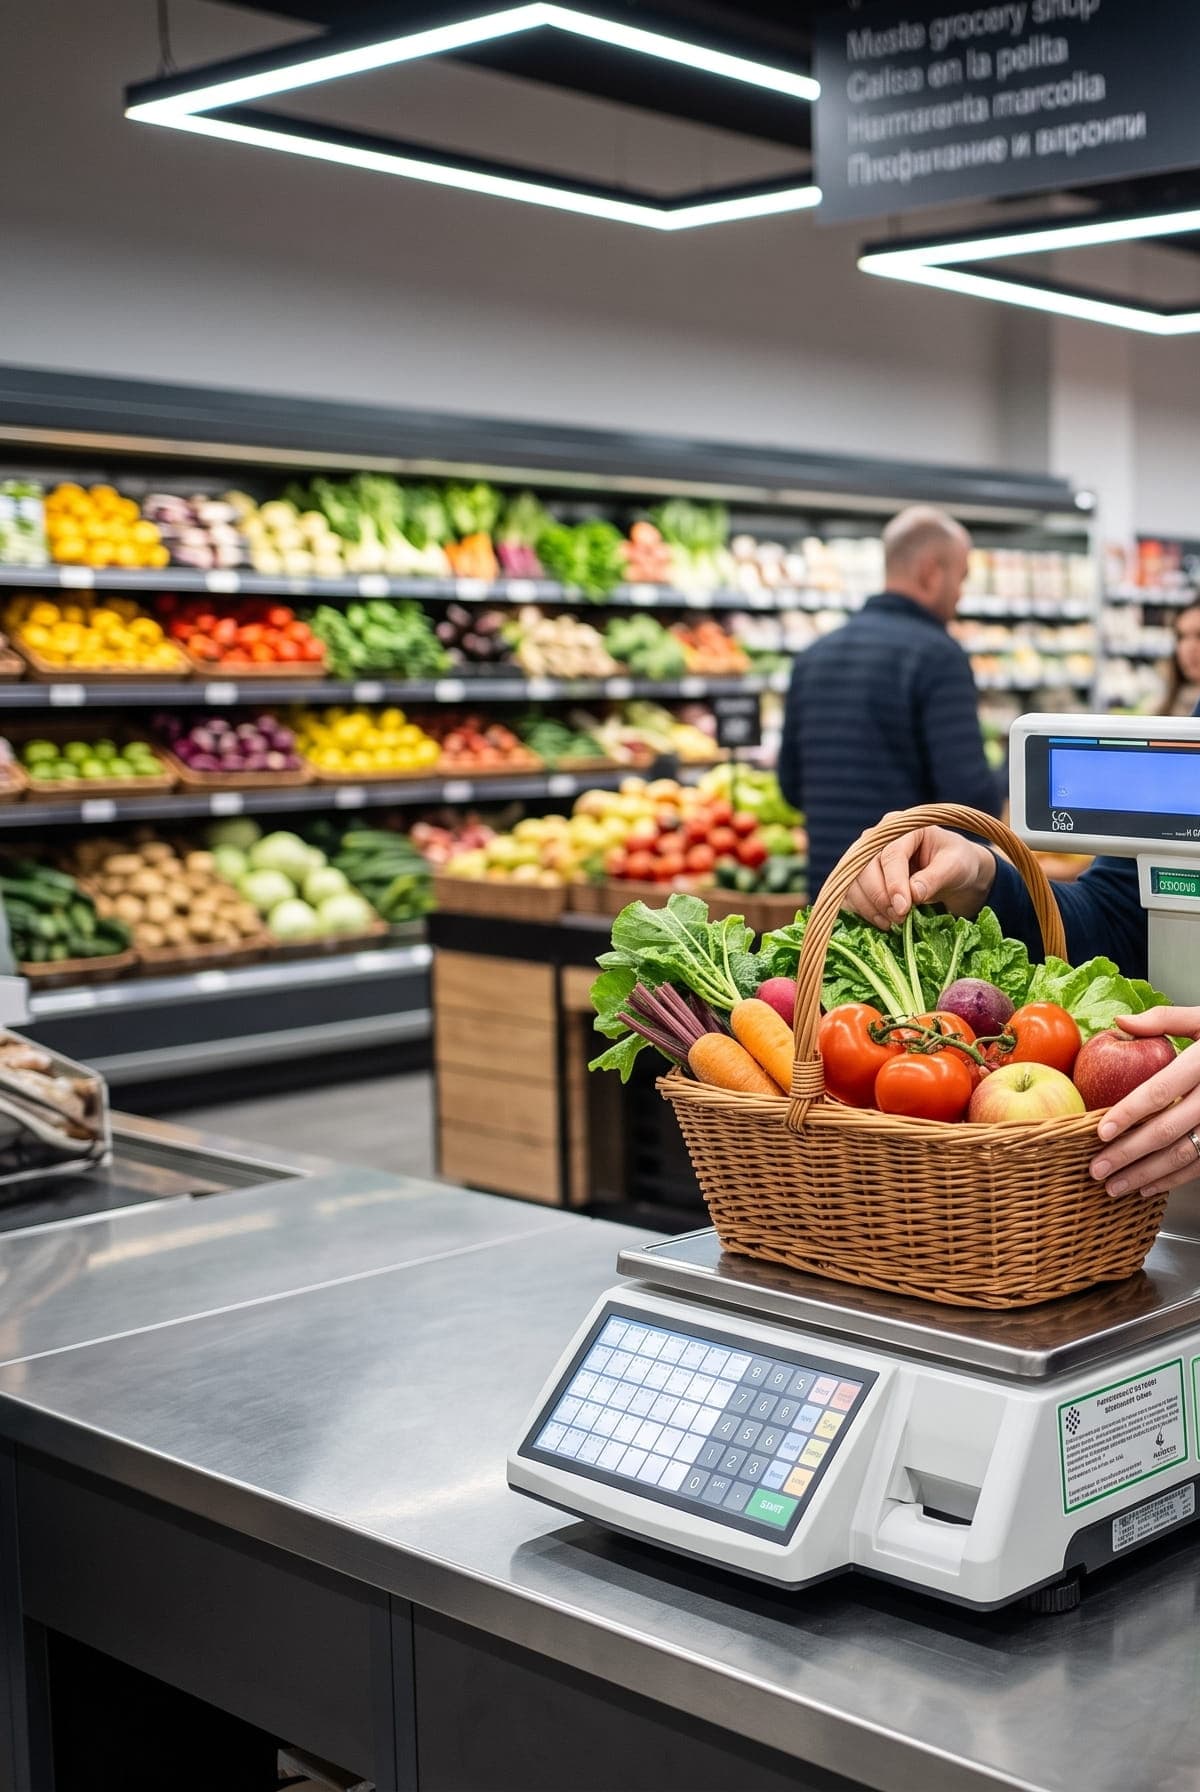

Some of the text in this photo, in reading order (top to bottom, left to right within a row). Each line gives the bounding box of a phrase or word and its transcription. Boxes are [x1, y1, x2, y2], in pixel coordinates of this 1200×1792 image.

[737, 1393, 748, 1405] 7
[721, 1422, 731, 1434] 4
[743, 1428, 753, 1440] 5
[726, 1455, 737, 1468] 2
[749, 1462, 759, 1475] 3
[690, 1476, 700, 1489] 0
